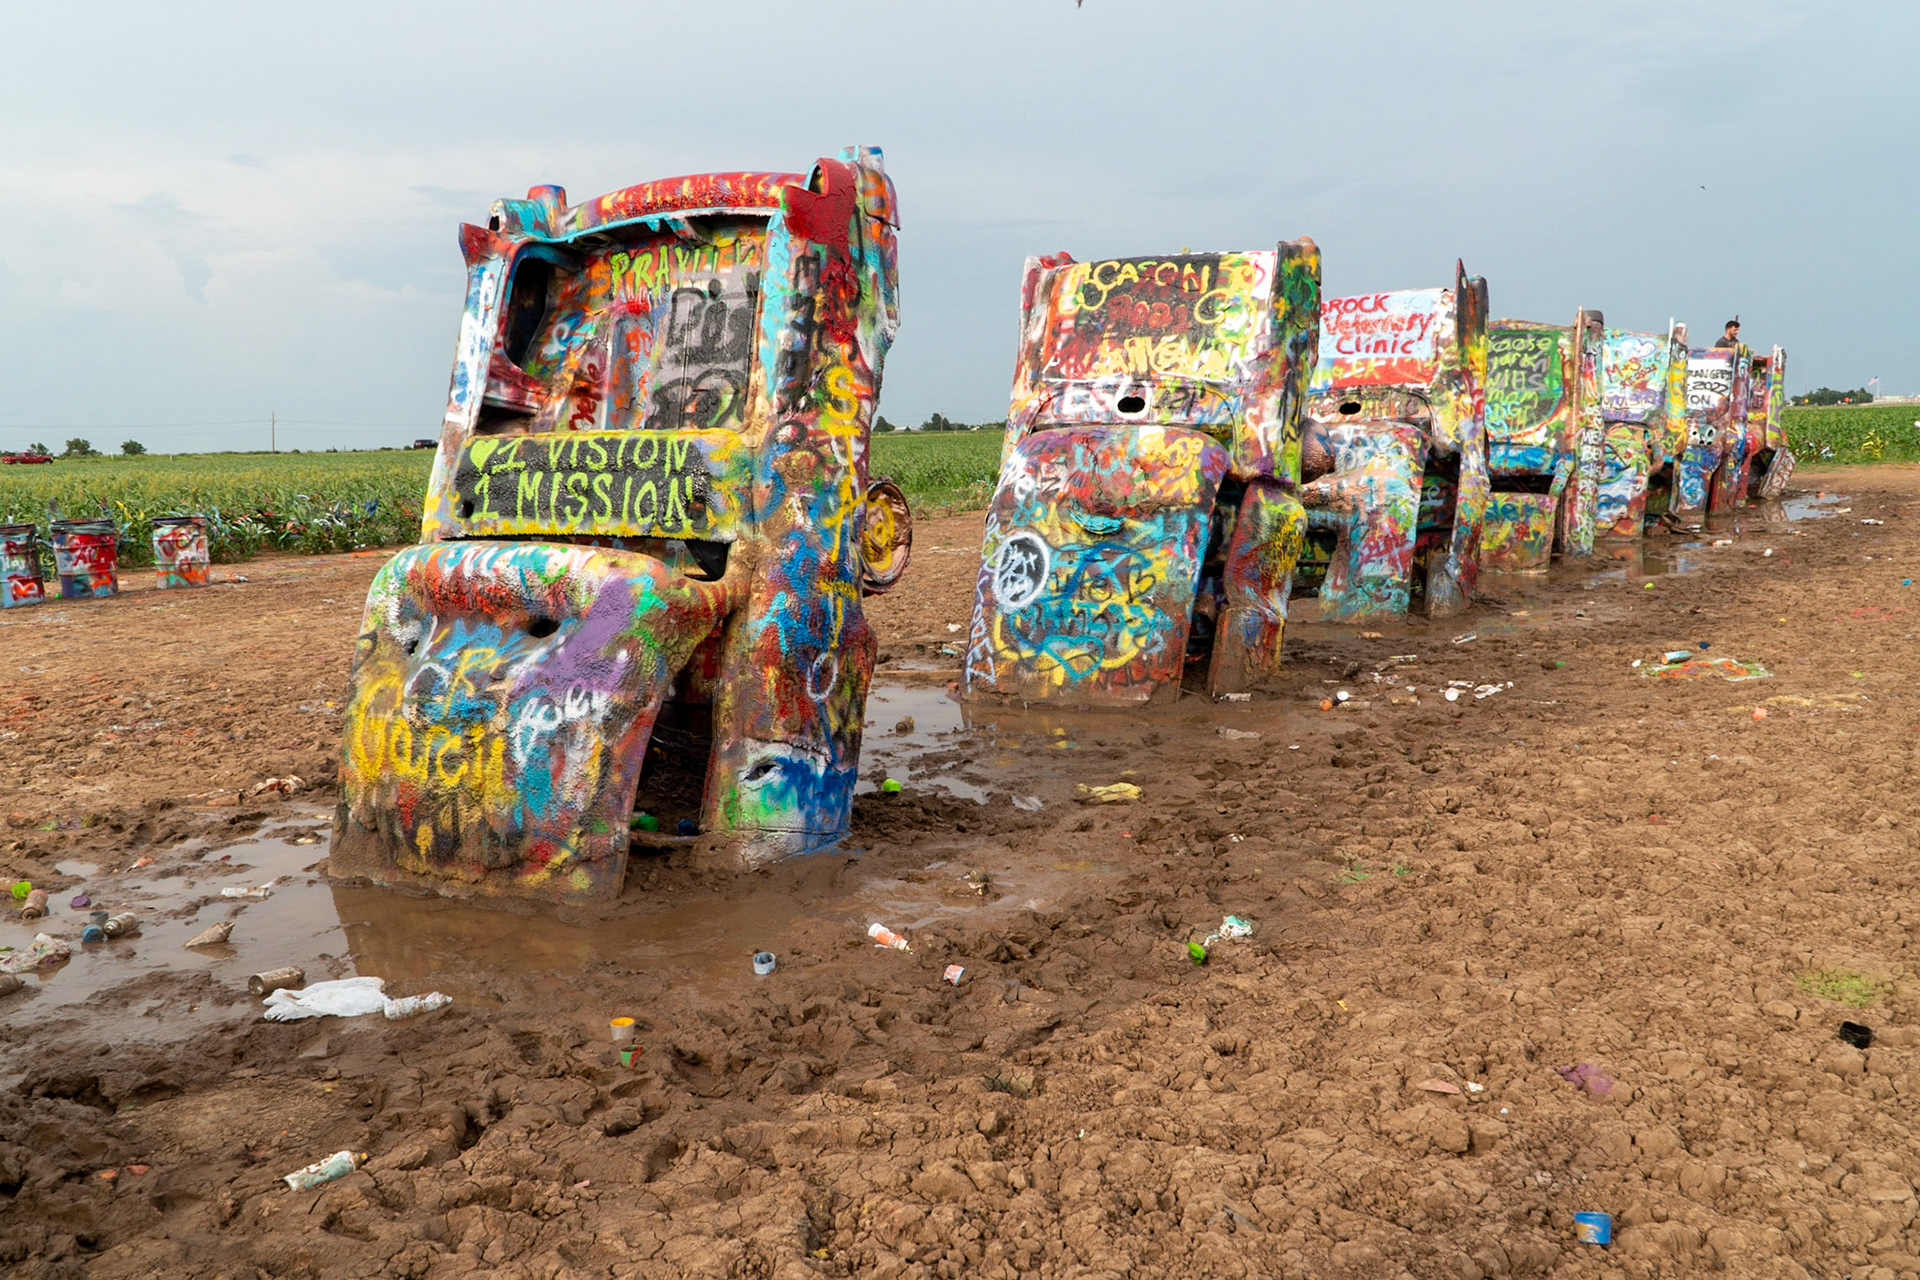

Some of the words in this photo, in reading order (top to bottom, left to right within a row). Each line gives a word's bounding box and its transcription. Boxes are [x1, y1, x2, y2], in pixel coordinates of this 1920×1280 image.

[1336, 334, 1414, 355] Clinic
[1488, 338, 1551, 352] oose
[1692, 380, 1729, 397] 2022
[549, 434, 697, 478] VISION
[515, 470, 694, 533] MISSION
